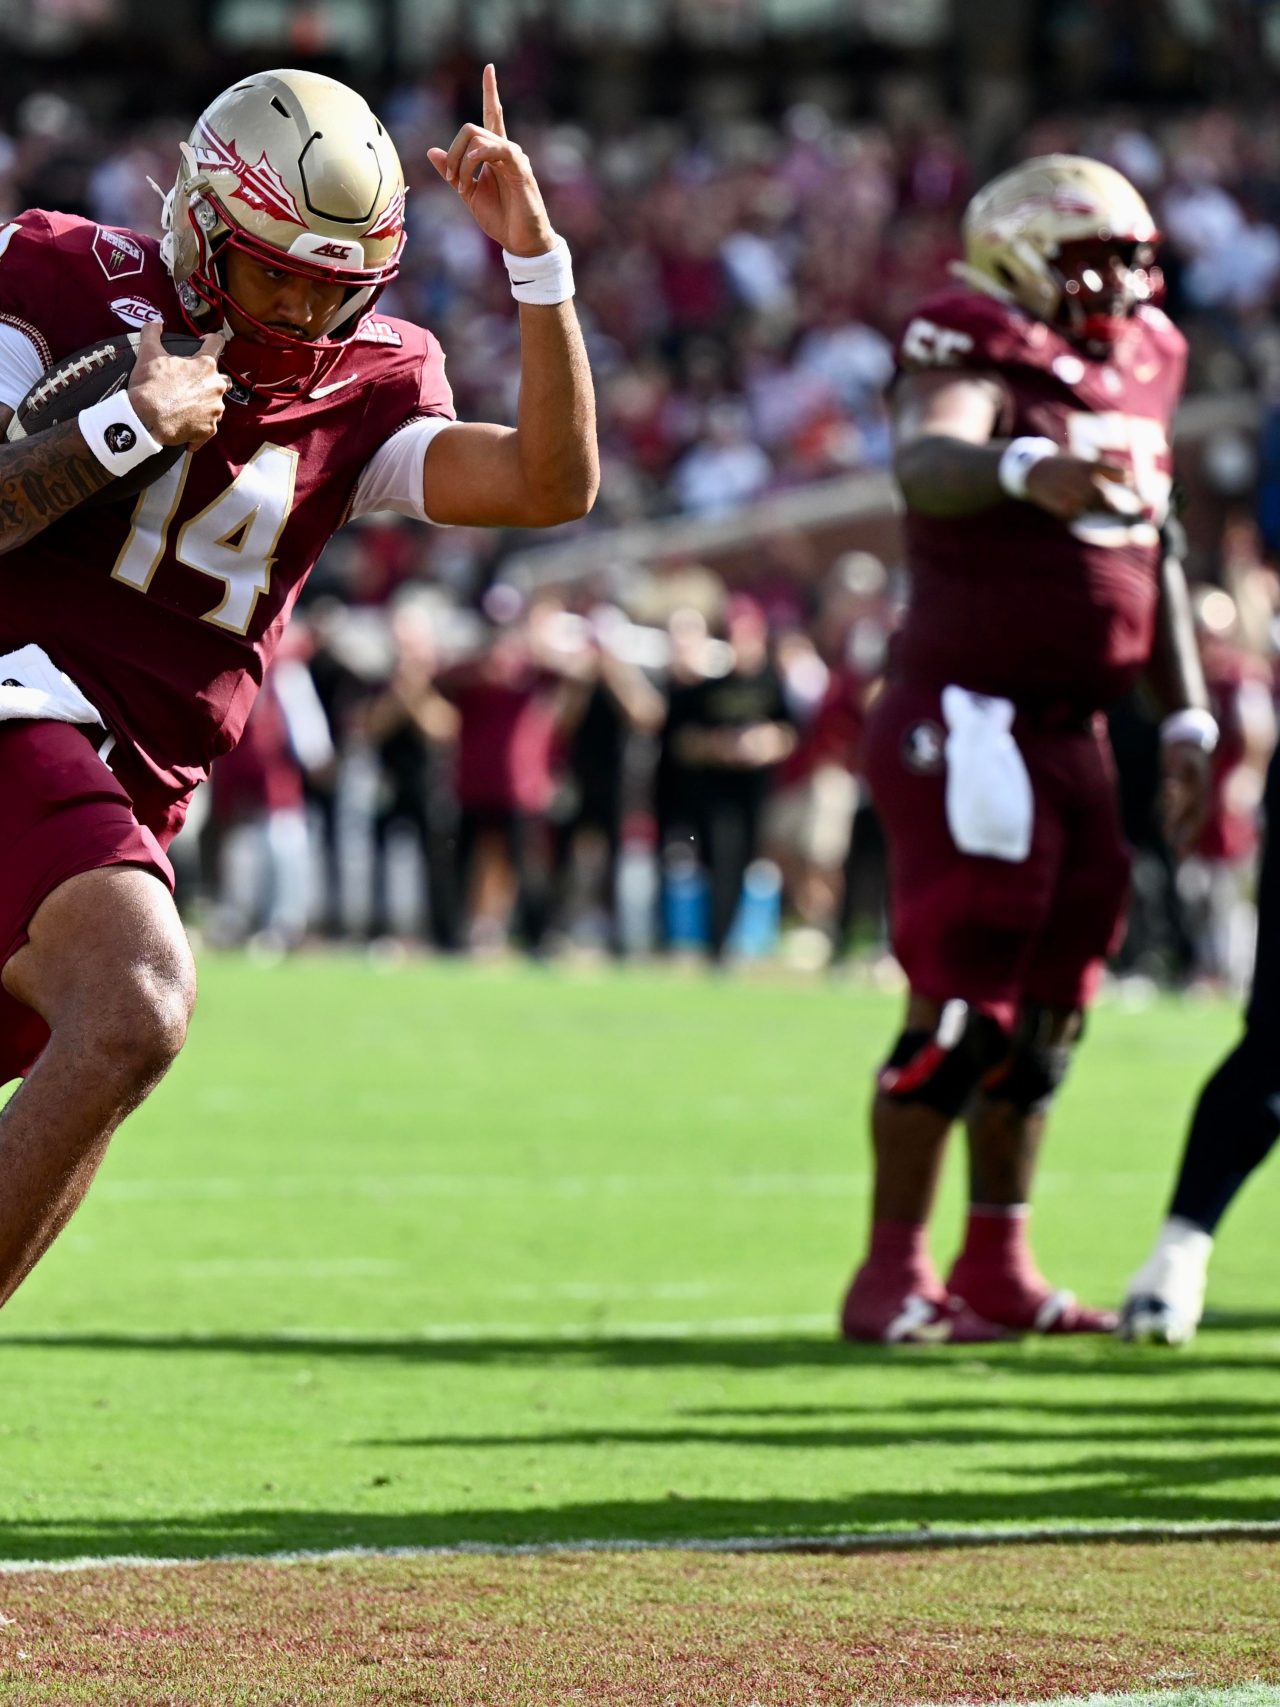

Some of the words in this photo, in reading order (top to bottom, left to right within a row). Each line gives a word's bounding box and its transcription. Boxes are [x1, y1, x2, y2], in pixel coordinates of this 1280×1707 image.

[310, 242, 353, 260] ACC
[116, 303, 160, 322] ACC
[110, 441, 300, 636] 14
